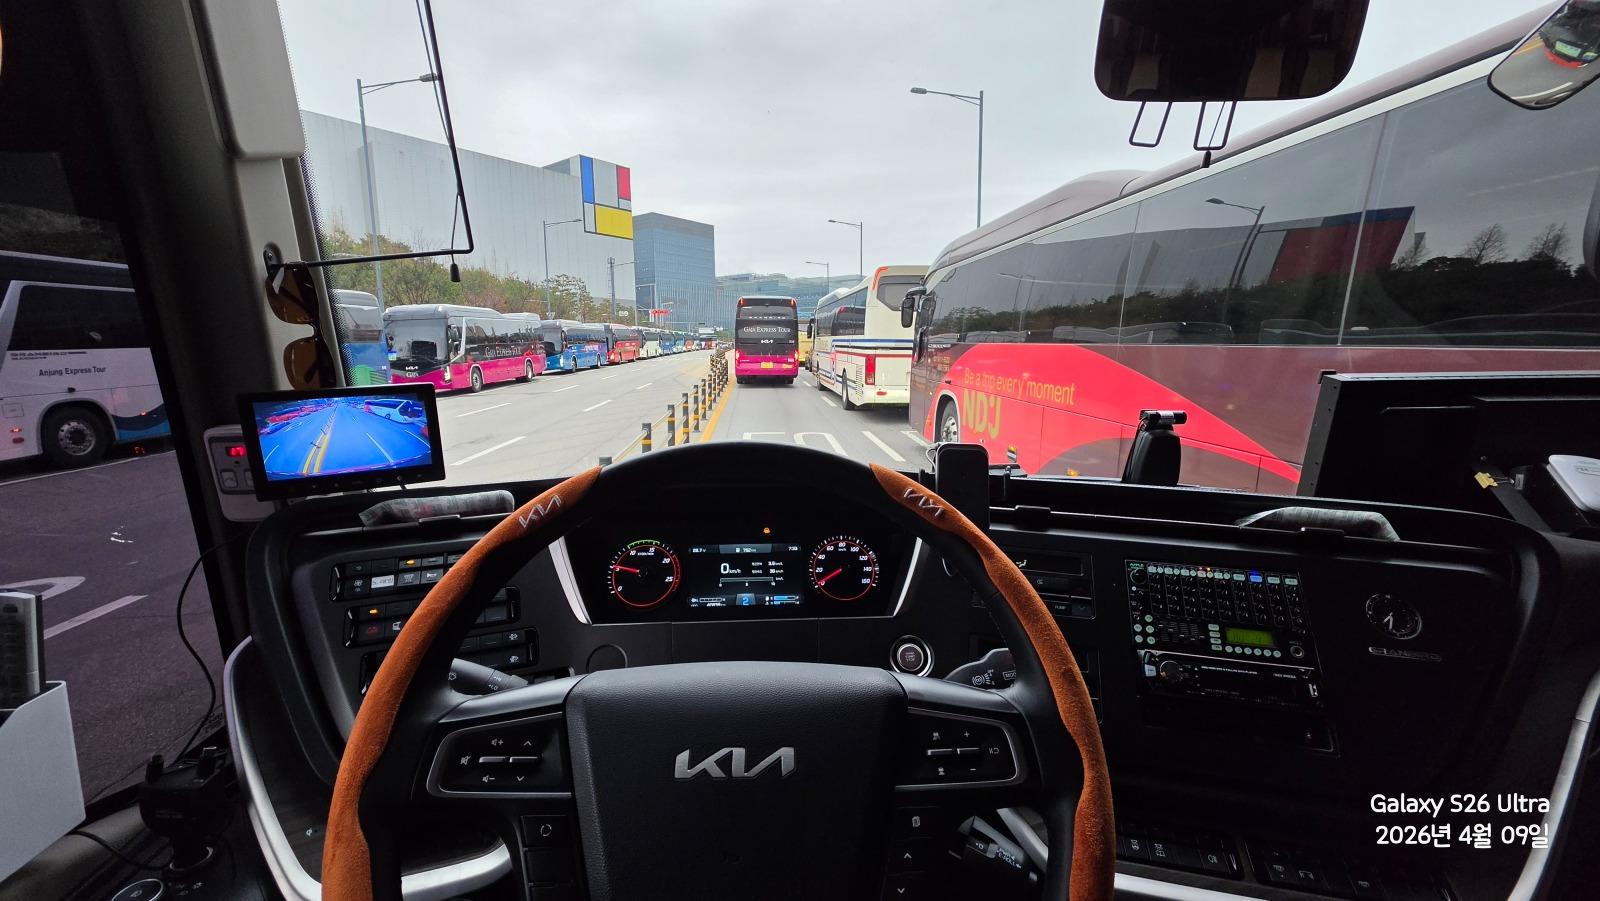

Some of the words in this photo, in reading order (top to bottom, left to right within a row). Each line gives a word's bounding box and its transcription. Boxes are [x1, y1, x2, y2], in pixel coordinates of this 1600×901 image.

[39, 369, 63, 377] Anjung
[65, 367, 92, 375] Express
[996, 376, 1023, 400] every
[1025, 380, 1076, 406] moment
[720, 563, 729, 574] 0
[742, 598, 750, 606] 2
[674, 747, 795, 779] KIA
